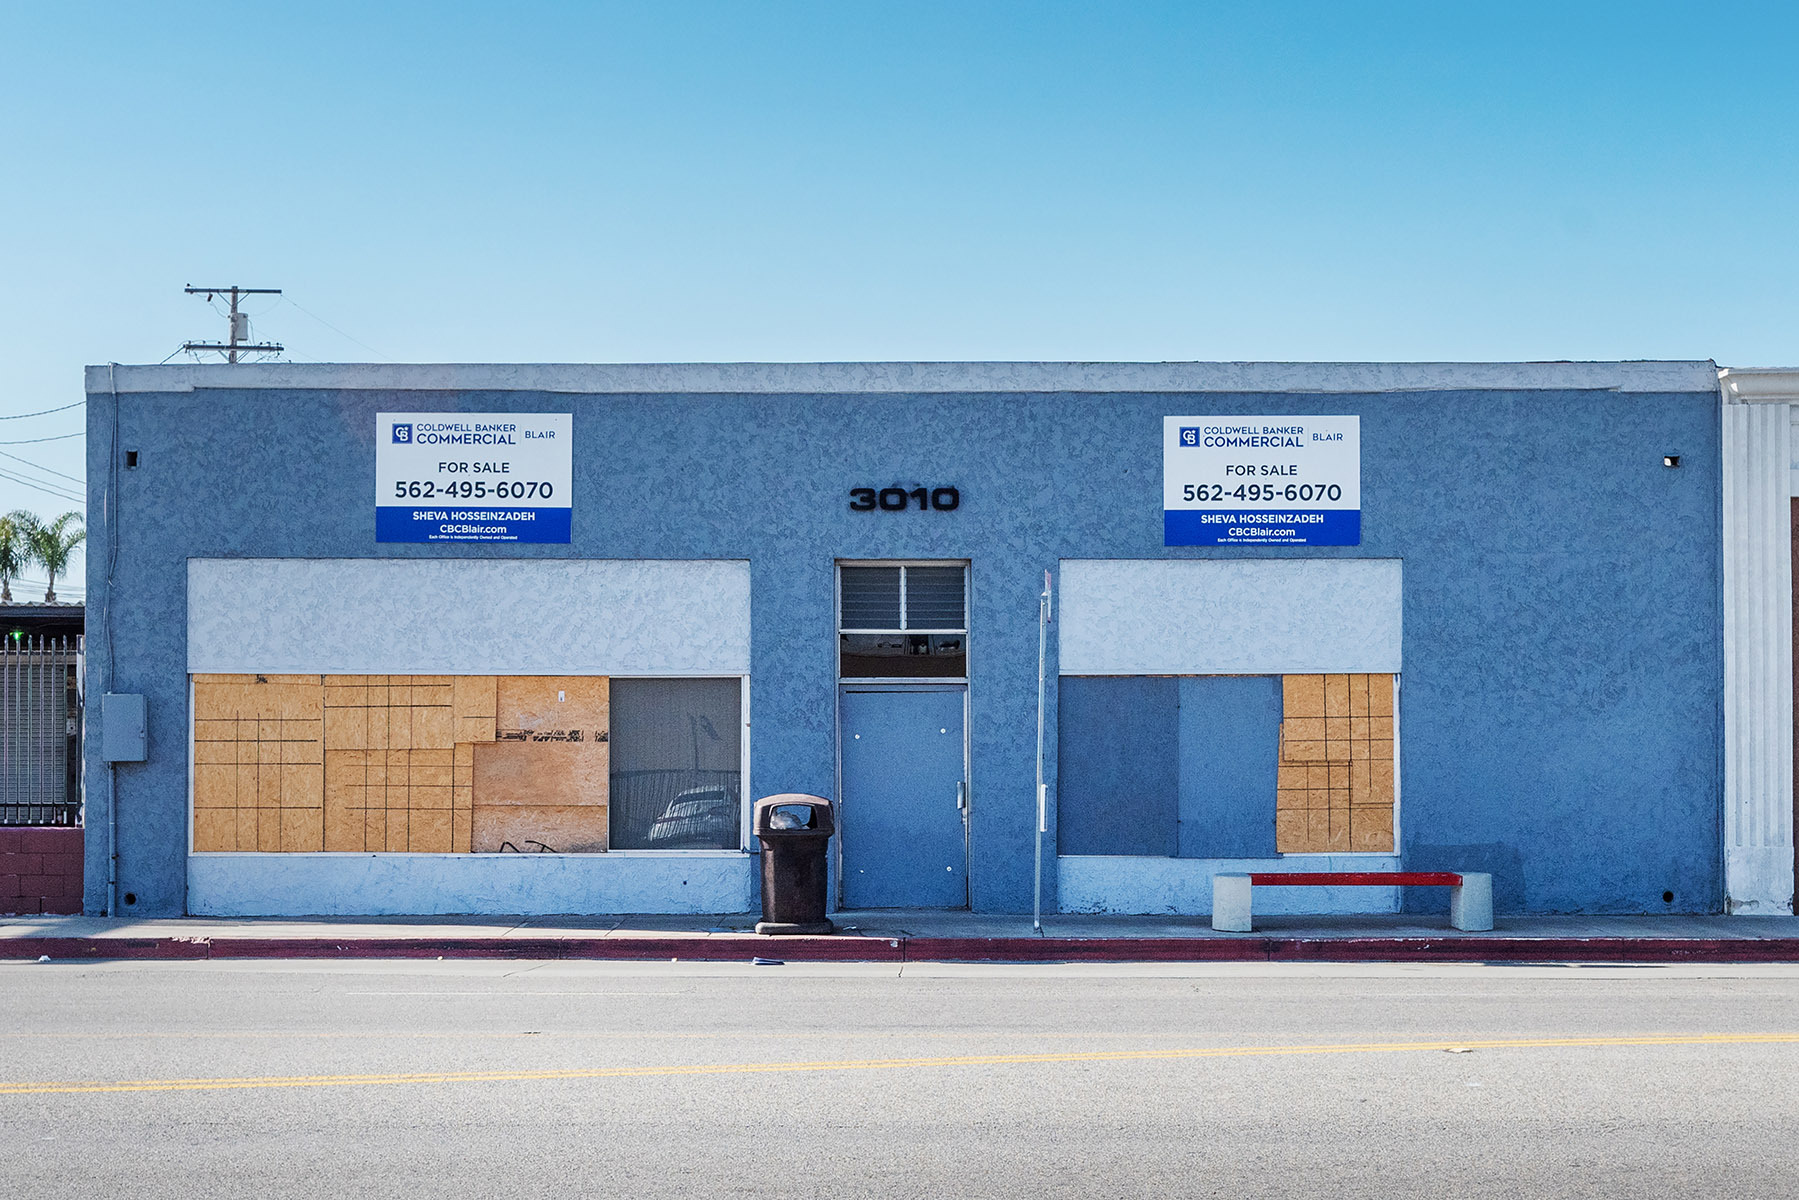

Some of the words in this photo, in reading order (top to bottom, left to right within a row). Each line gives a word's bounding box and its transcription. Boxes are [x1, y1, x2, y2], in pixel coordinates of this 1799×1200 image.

[416, 423, 472, 432] COLDWELL
[474, 423, 516, 432] BANKER
[1204, 426, 1259, 435] COLDWELL
[1262, 426, 1304, 435] BANKER
[416, 433, 516, 445] COMMERCIAL
[525, 430, 556, 439] BLAIR
[1312, 433, 1343, 441] BLAIR
[1204, 436, 1304, 448] COMMERCIAL
[438, 462, 469, 473] FOR
[473, 462, 510, 473] SALE
[1226, 465, 1256, 476] FOR
[1260, 465, 1298, 476] SALE
[395, 481, 554, 499] 562-495-6070
[1183, 484, 1342, 501] 562-495-6070
[849, 487, 960, 511] 3010
[412, 511, 448, 521] SHEVA
[451, 511, 536, 521] HOSSEINZADEH
[1201, 514, 1237, 524] SHEVA
[1239, 514, 1324, 524] HOSSEINZADEH
[439, 524, 507, 534] CBCBlair.com
[1228, 527, 1296, 537] CBCBlair.com
